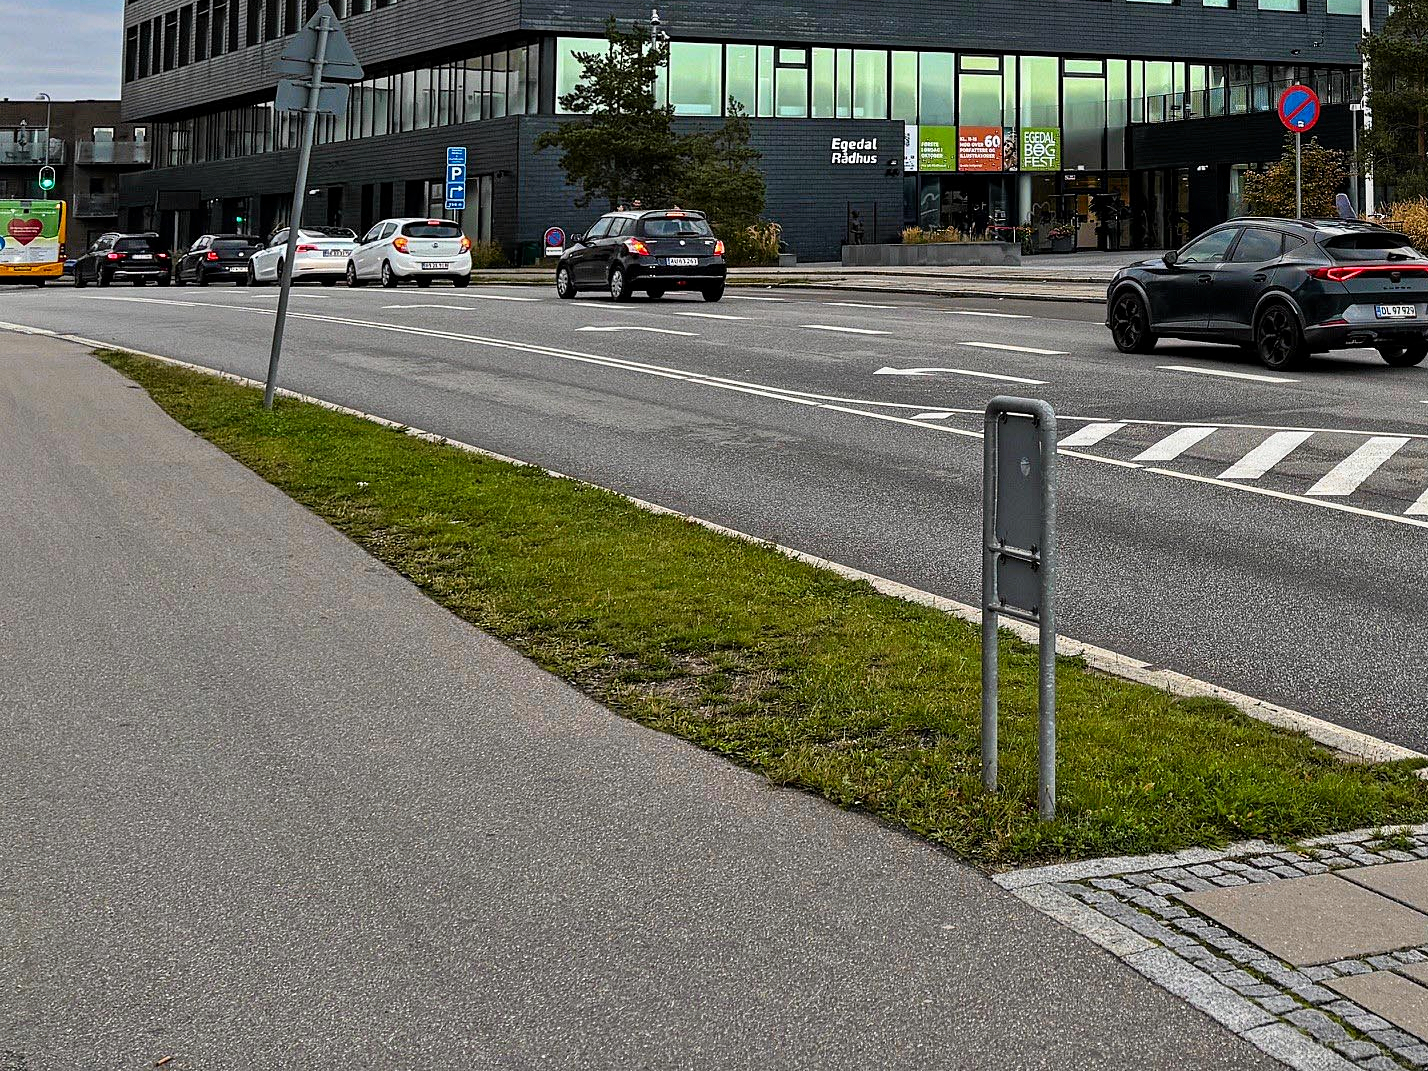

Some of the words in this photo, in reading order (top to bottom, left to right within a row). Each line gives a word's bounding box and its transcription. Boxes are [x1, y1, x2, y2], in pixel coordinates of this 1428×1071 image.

[984, 135, 1001, 148] 60
[1024, 131, 1056, 144] EGEDAL
[831, 137, 878, 153] Egedal
[831, 151, 878, 164] Rådhus
[1024, 156, 1056, 168] FEST
[451, 166, 463, 181] P
[1392, 306, 1401, 315] 97
